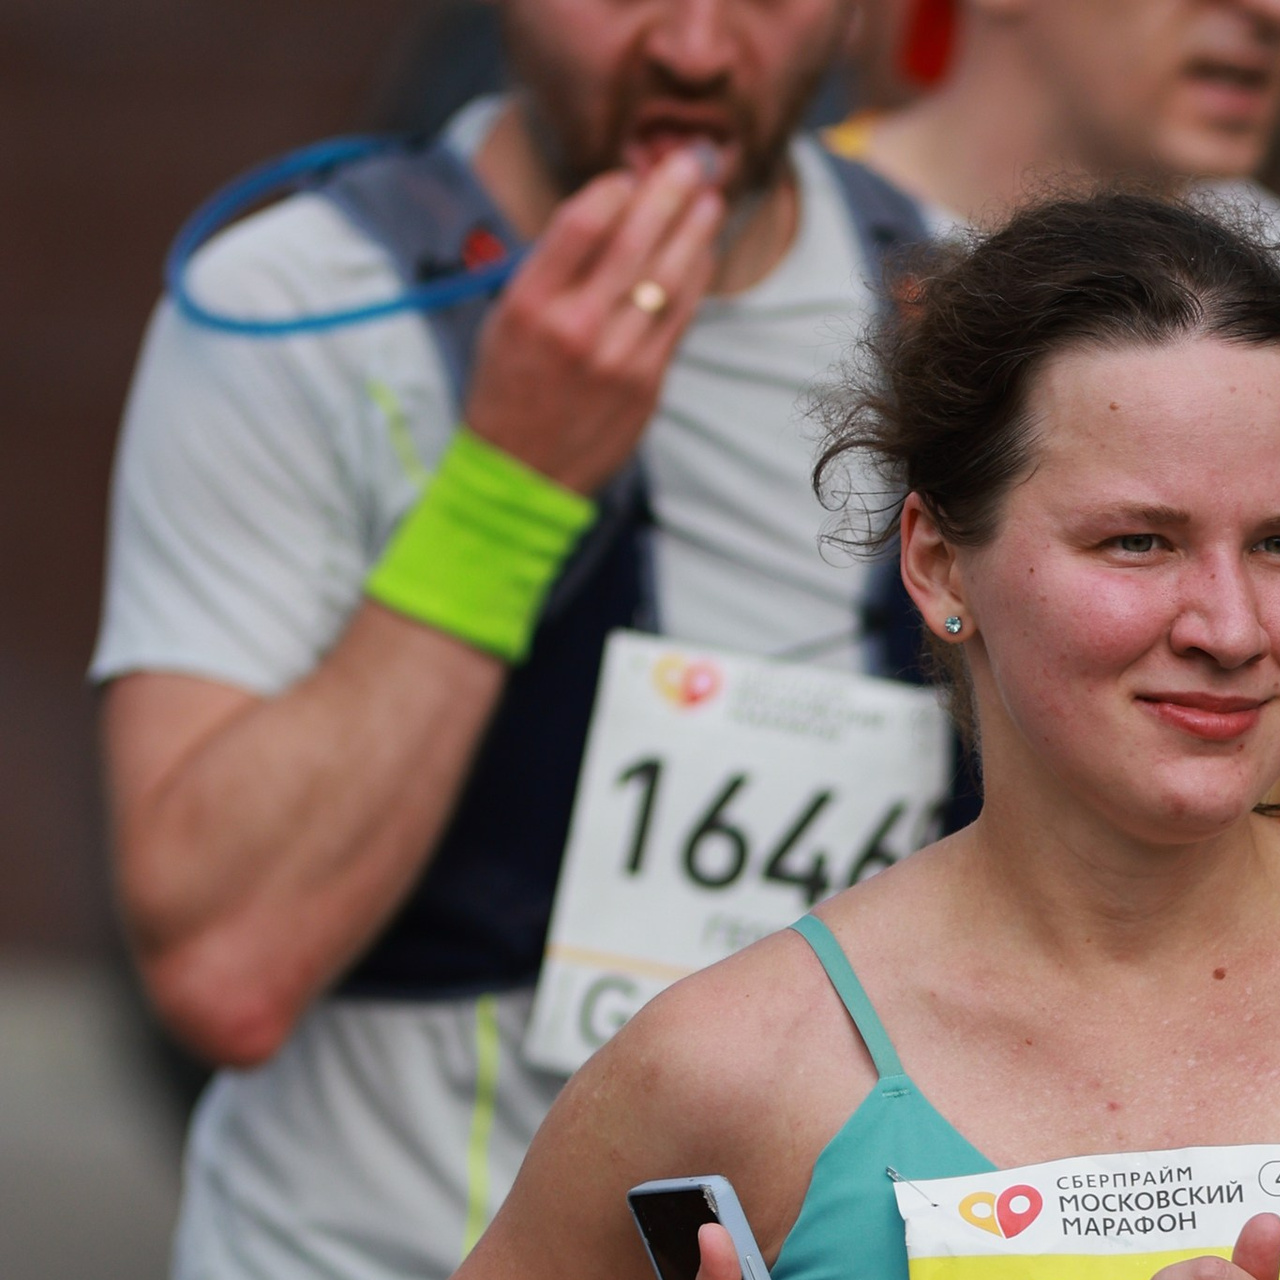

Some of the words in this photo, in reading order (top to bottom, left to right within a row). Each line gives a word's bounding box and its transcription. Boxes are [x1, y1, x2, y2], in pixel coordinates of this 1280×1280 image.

[1056, 1165, 1193, 1190] СБЕРПРАЙМ
[1059, 1180, 1244, 1213] МОСКОВСКИЙ
[1062, 1210, 1197, 1237] МАРАФОН
